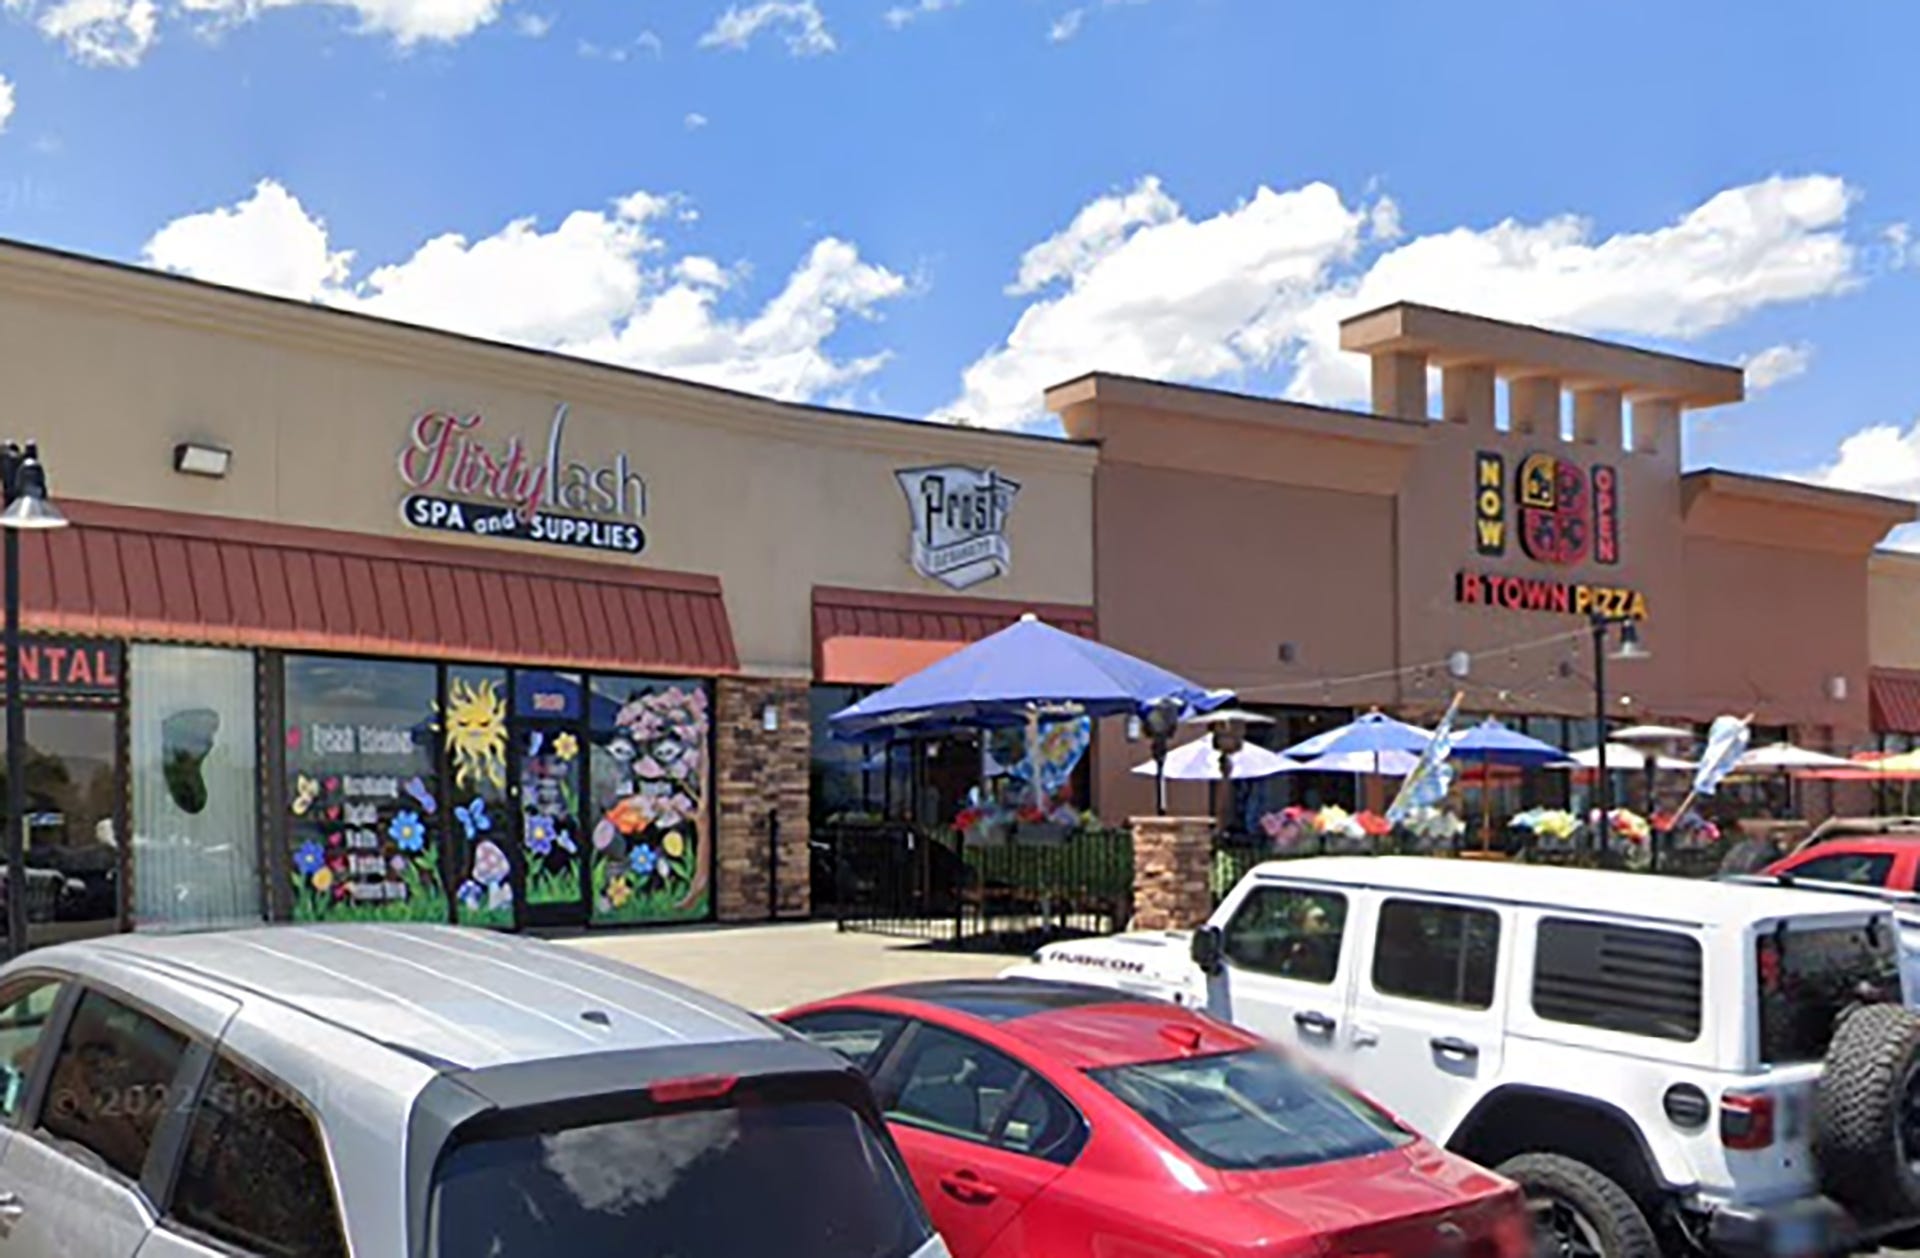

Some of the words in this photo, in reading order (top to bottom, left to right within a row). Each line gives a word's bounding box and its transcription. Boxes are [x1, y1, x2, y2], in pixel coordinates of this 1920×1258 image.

[414, 500, 465, 529] SPA
[473, 509, 516, 533] and
[530, 515, 639, 549] SUPPLIES
[1479, 458, 1505, 548] NOW
[1595, 468, 1614, 562] OPEN
[1049, 950, 1145, 974] RUBICON
